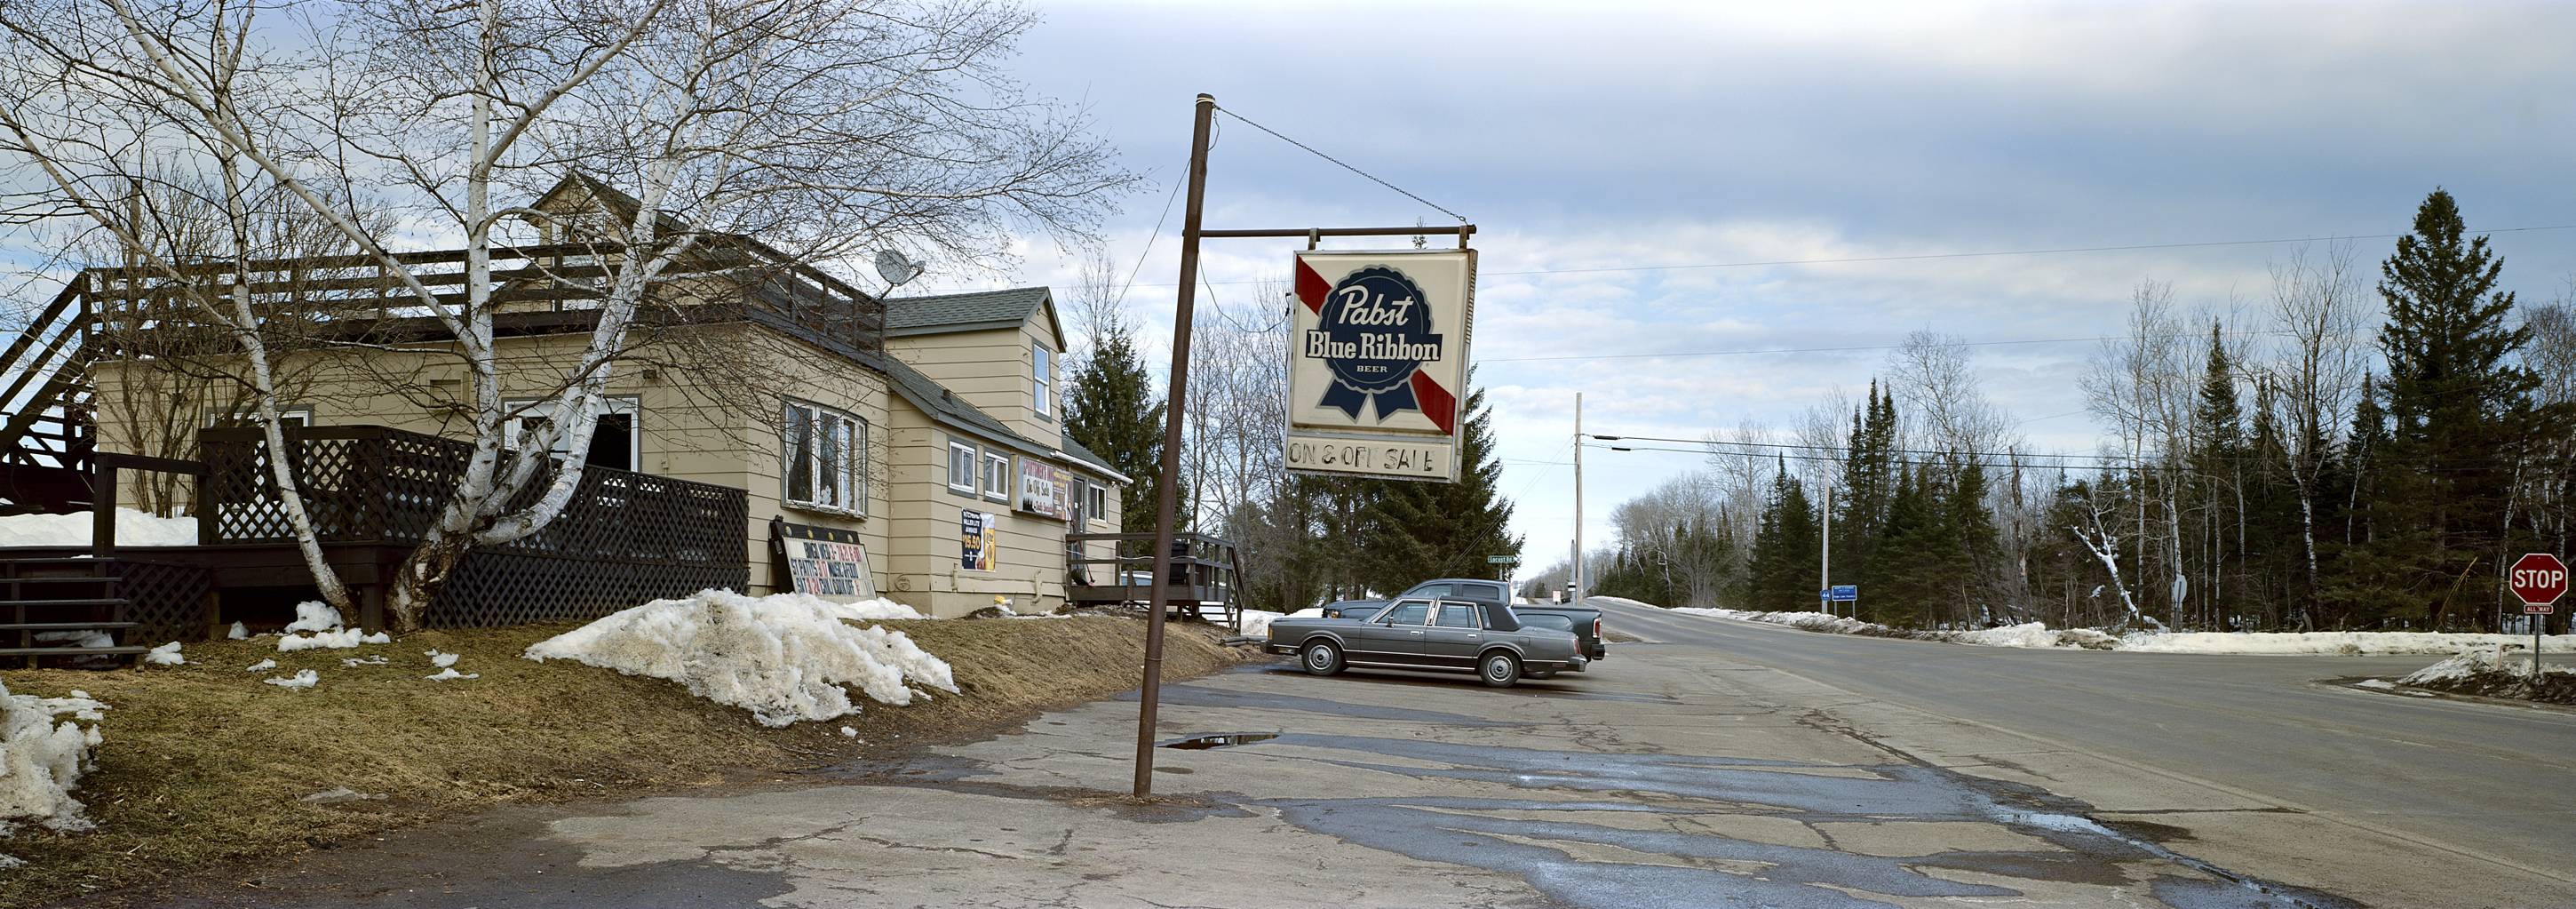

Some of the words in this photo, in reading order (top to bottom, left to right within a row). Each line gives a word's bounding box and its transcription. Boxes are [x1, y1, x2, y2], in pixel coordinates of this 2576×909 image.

[1338, 285, 1414, 326] Pabst
[1307, 331, 1356, 359] Blue
[1359, 332, 1440, 361] Ribbon
[1356, 364, 1388, 373] BEER
[1289, 443, 1316, 465] ON
[1321, 444, 1336, 464] &
[791, 558, 799, 576] ST
[796, 578, 807, 594] SAT
[2514, 569, 2564, 588] STOP
